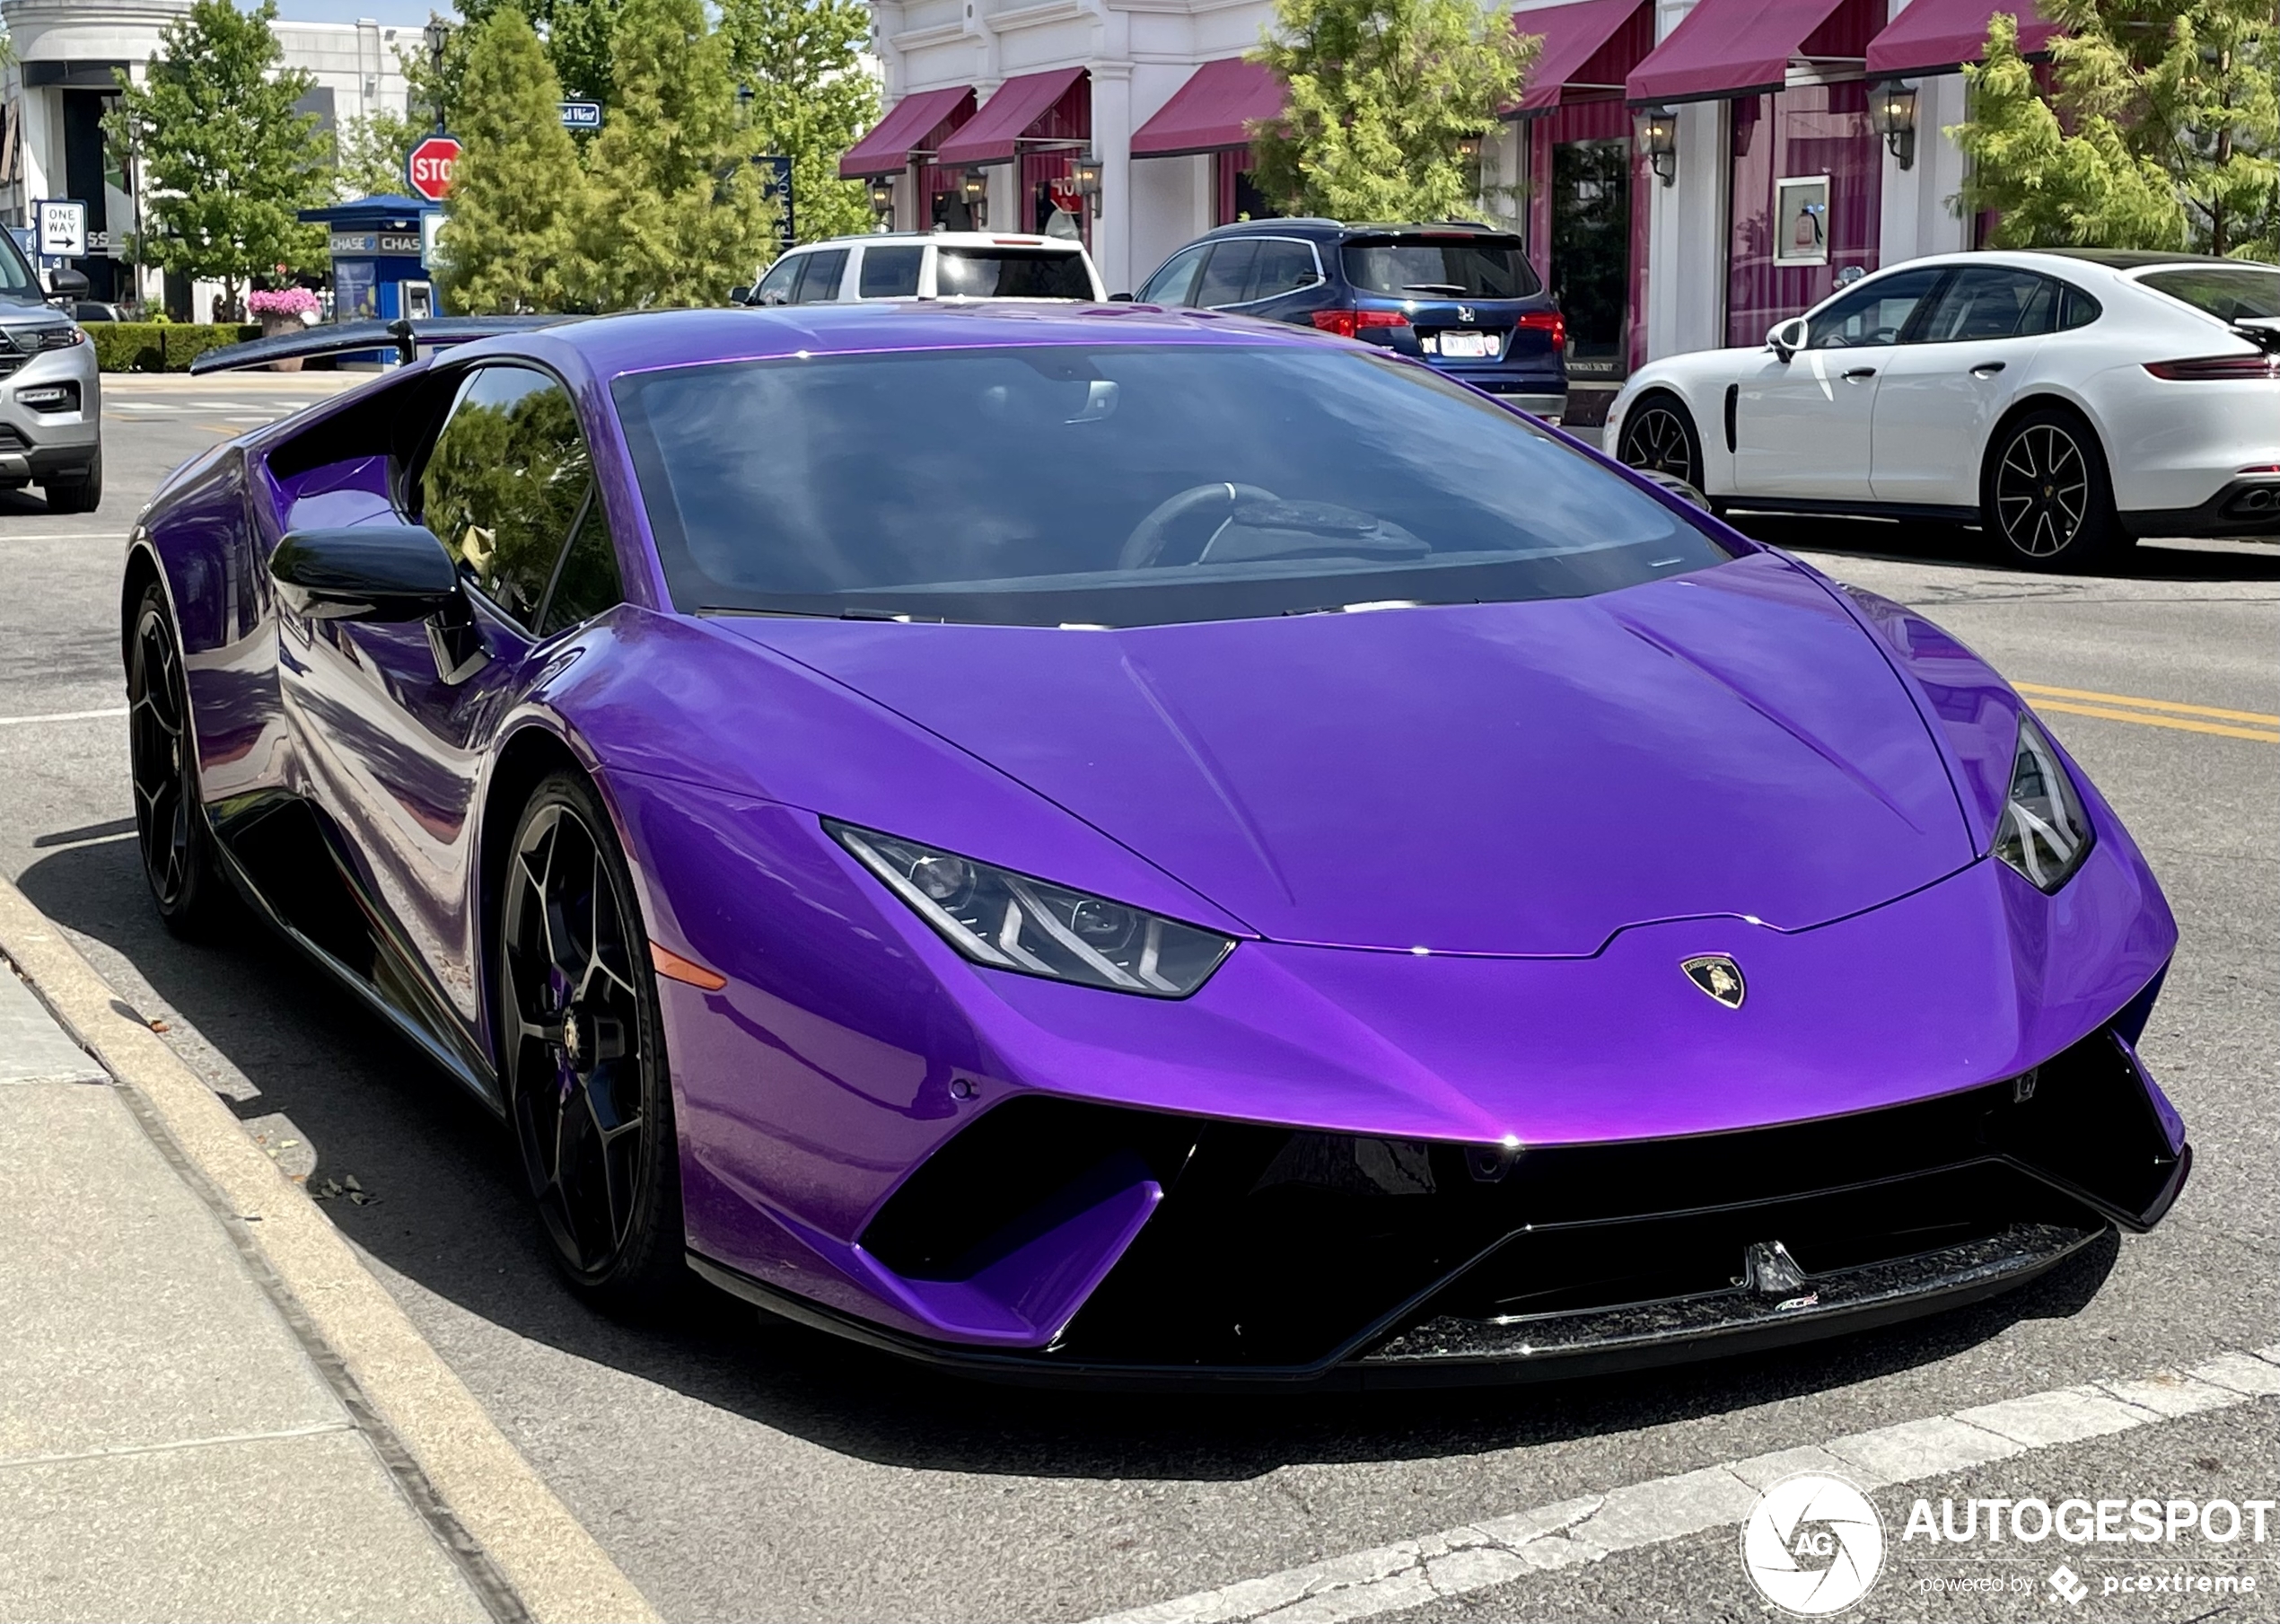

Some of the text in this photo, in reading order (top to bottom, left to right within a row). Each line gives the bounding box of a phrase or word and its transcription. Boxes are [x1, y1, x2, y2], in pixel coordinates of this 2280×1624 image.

[574, 108, 595, 120] West
[416, 158, 452, 181] STO
[49, 208, 75, 221] ONE
[48, 222, 75, 233] WAY
[330, 237, 365, 251] CHASE
[381, 237, 421, 251] CHAS
